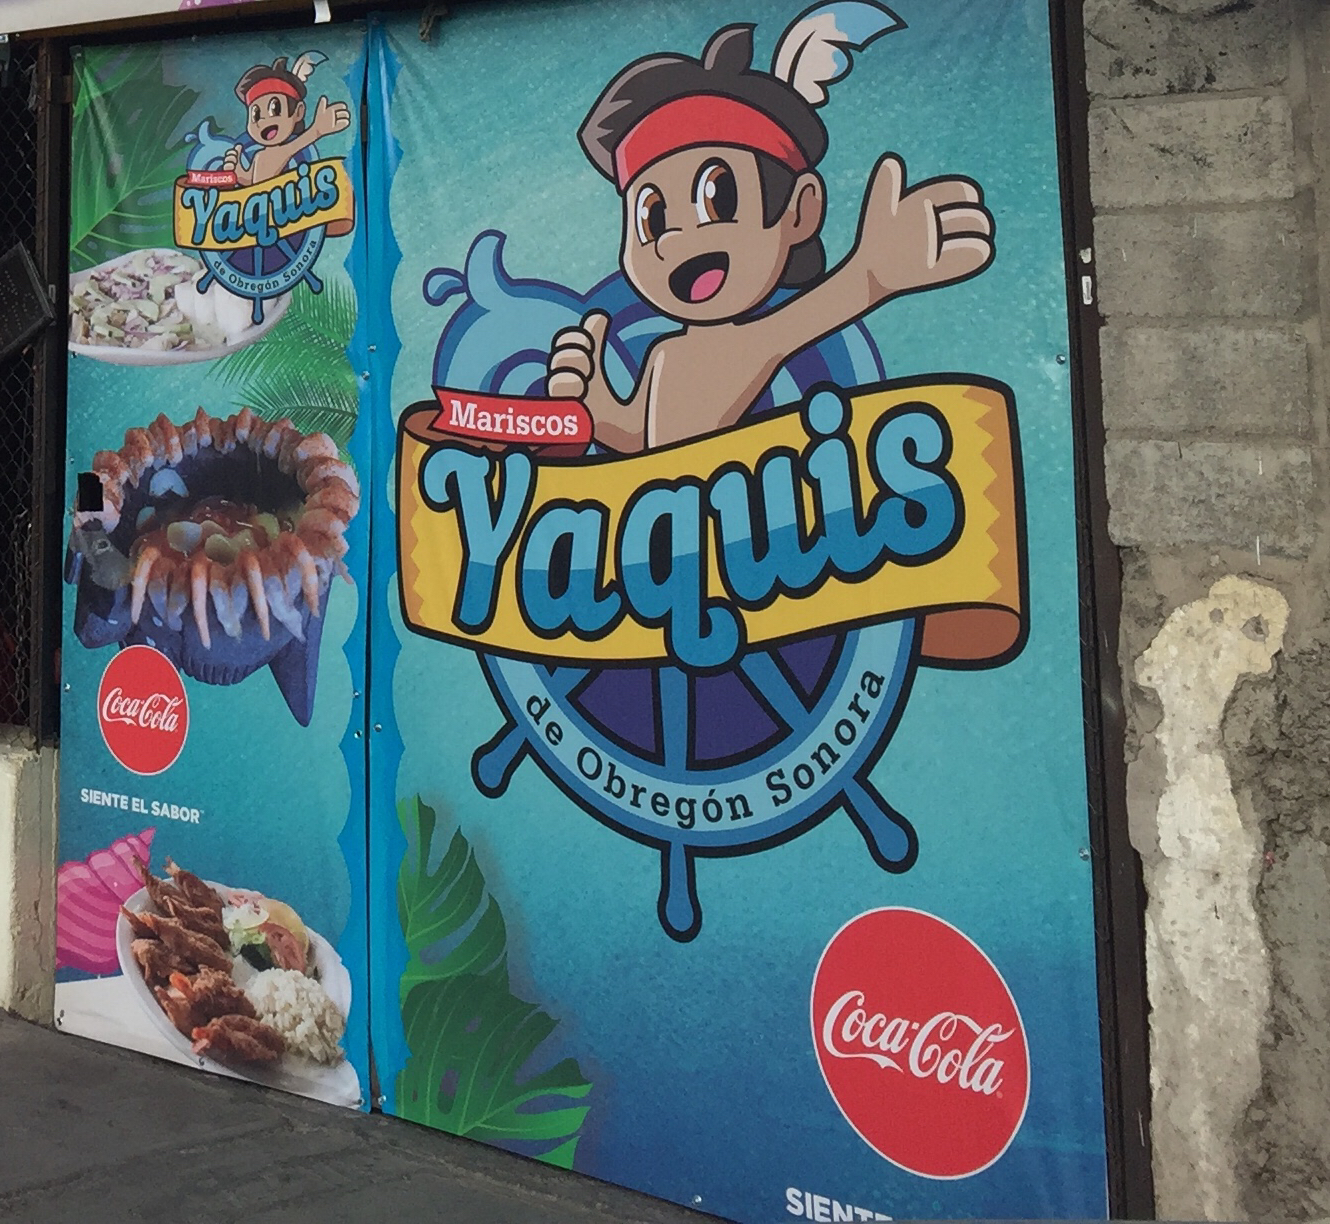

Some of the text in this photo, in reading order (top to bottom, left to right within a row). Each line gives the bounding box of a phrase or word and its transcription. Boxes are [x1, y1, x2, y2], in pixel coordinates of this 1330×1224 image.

[191, 172, 233, 184] Mariscos
[181, 163, 339, 247] Yaquis
[213, 239, 317, 293] de Obregón Sonora
[448, 399, 579, 437] Mariscos
[420, 389, 961, 671] Yaquis
[102, 686, 183, 732] Coca-Cola
[526, 669, 886, 829] de Obregón Sonora
[80, 788, 200, 824] SIENTE EL SABOR
[822, 990, 1016, 1095] Coca-Cola
[785, 1186, 893, 1222] SIENT
